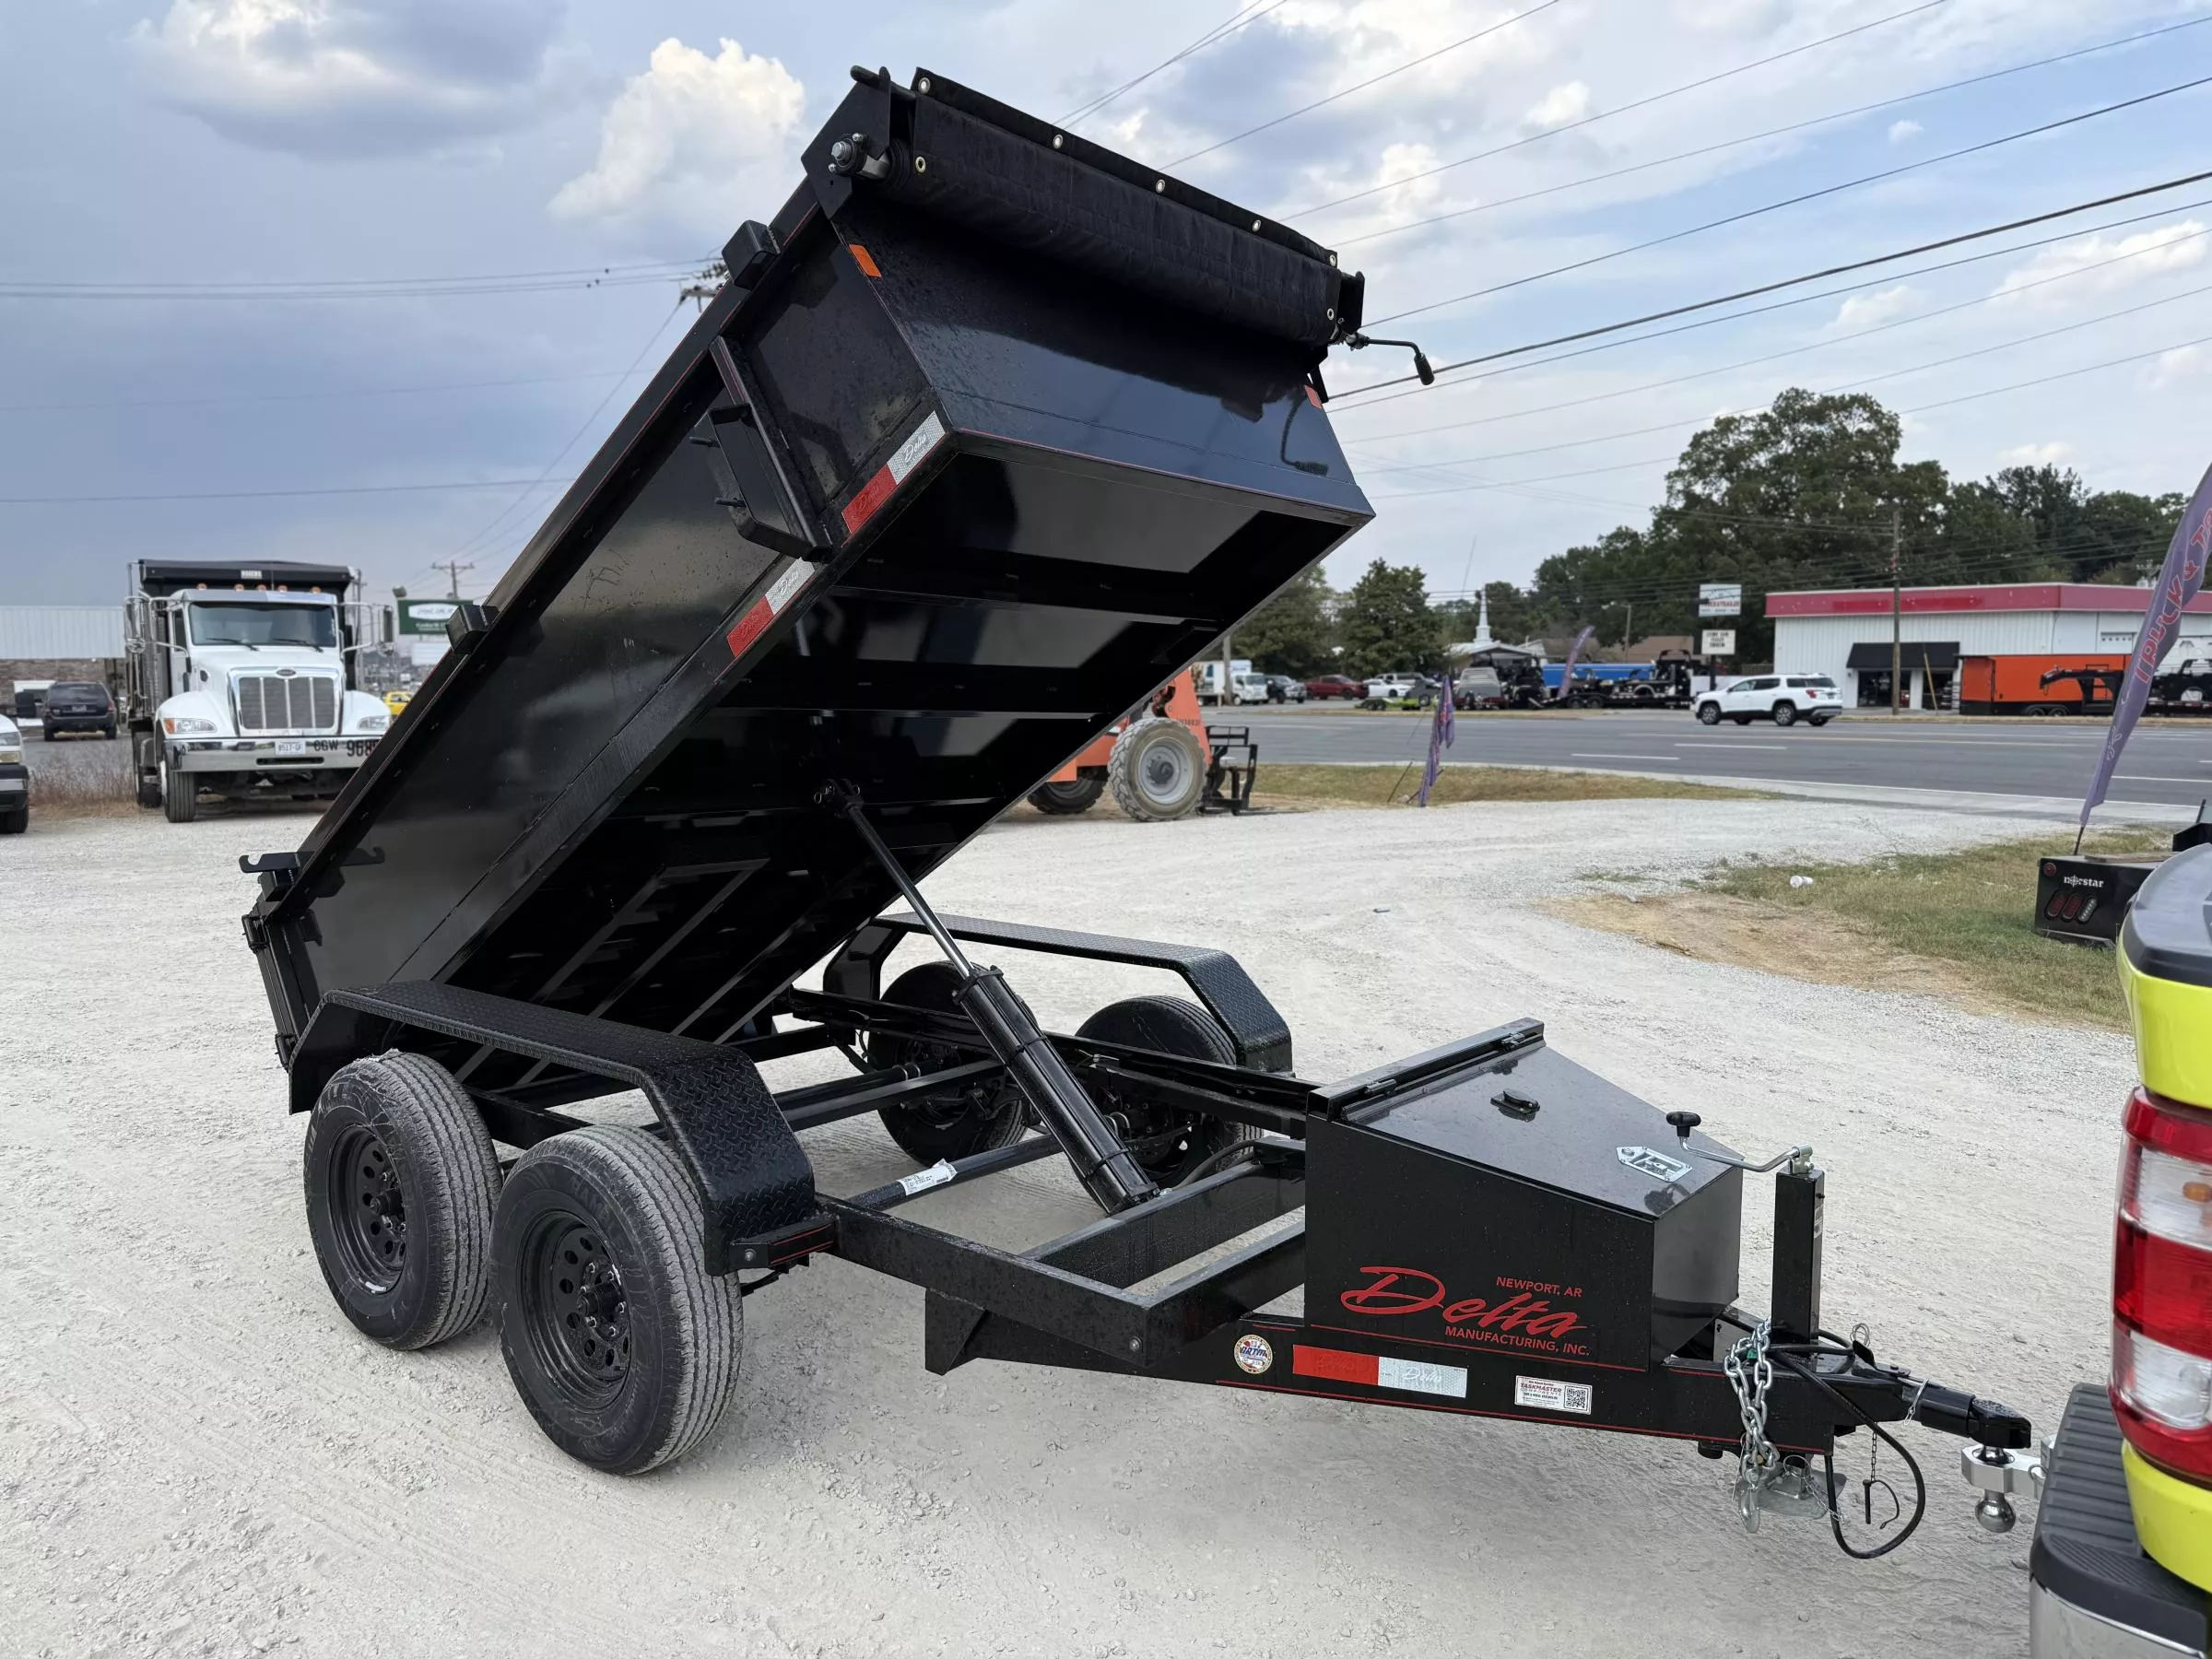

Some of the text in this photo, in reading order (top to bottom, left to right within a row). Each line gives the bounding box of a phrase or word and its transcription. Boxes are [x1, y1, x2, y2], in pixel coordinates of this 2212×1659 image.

[347, 739, 379, 757] 968
[1496, 1276, 1583, 1298] NEWPORT, AR
[1341, 1265, 1588, 1339] Delta
[1444, 1325, 1590, 1357] MANUFACTURING, INC.
[1520, 1382, 1562, 1394] TASKMASTER
